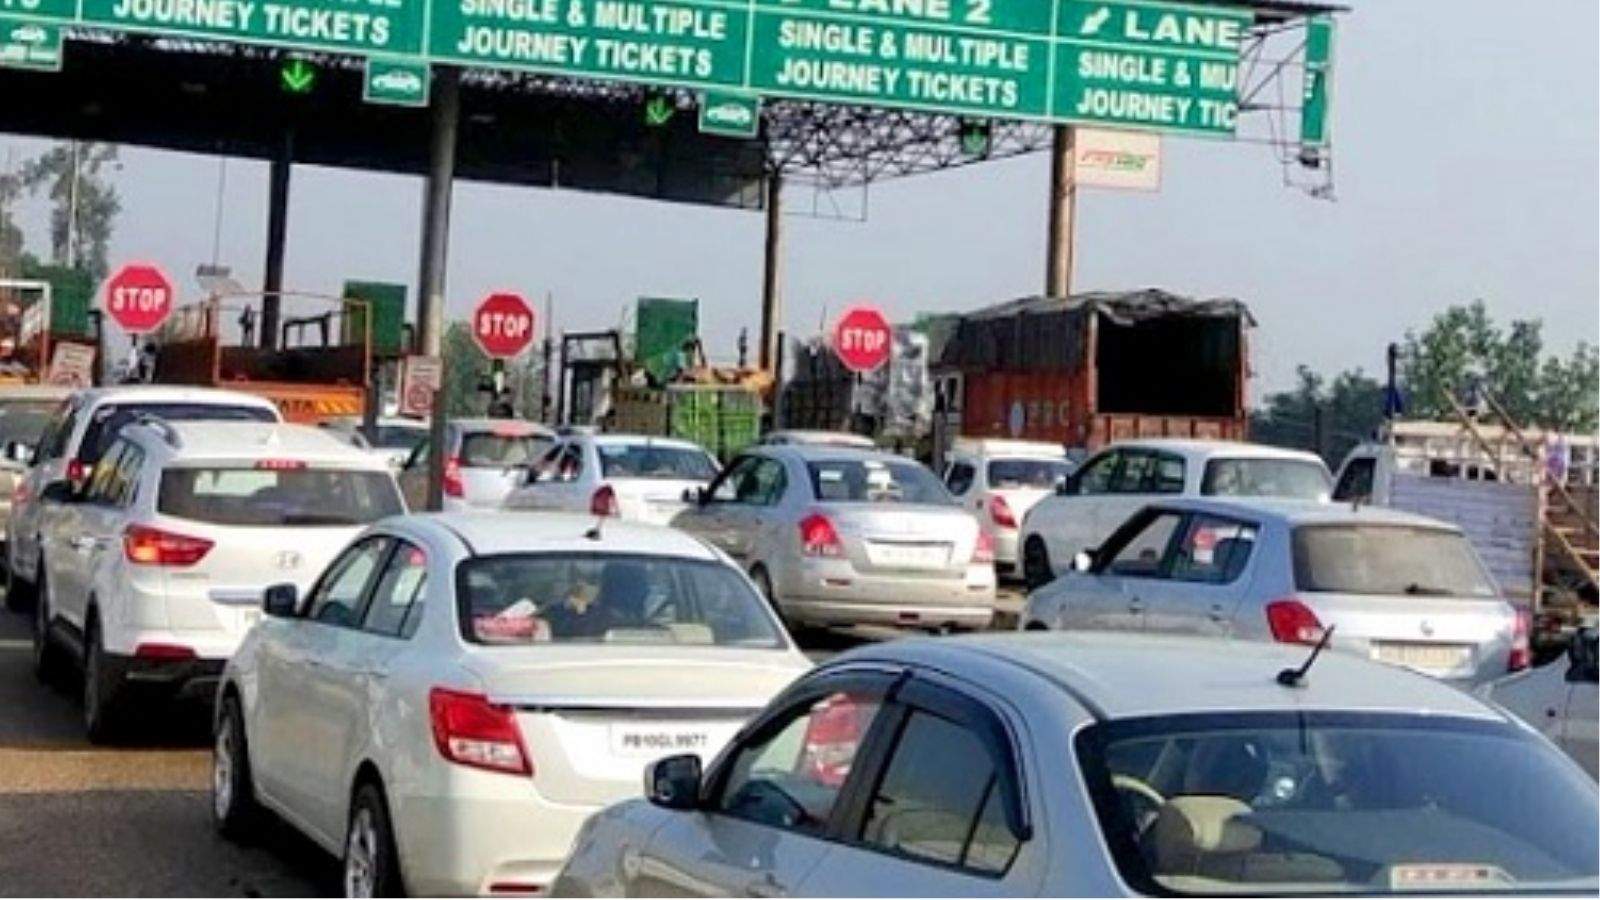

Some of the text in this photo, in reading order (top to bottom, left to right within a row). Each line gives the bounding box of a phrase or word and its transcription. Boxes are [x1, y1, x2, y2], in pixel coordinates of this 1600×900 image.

[112, 0, 390, 45] JOURNEY TICKETS
[460, 0, 728, 40] SINGLE & MULTIPLE
[964, 0, 993, 23] 2
[1125, 10, 1240, 48] LANE
[458, 26, 713, 77] JOURNEY TICKETS
[778, 20, 1029, 71] SINGLE & MULTIPLE
[777, 58, 1018, 107] JOURNEY TICKETS
[1078, 51, 1237, 91] SINGLE & MU
[1076, 87, 1237, 127] JOURNEY TIC
[112, 285, 166, 312] STOP
[480, 312, 530, 338] STOP
[841, 328, 886, 352] STOP
